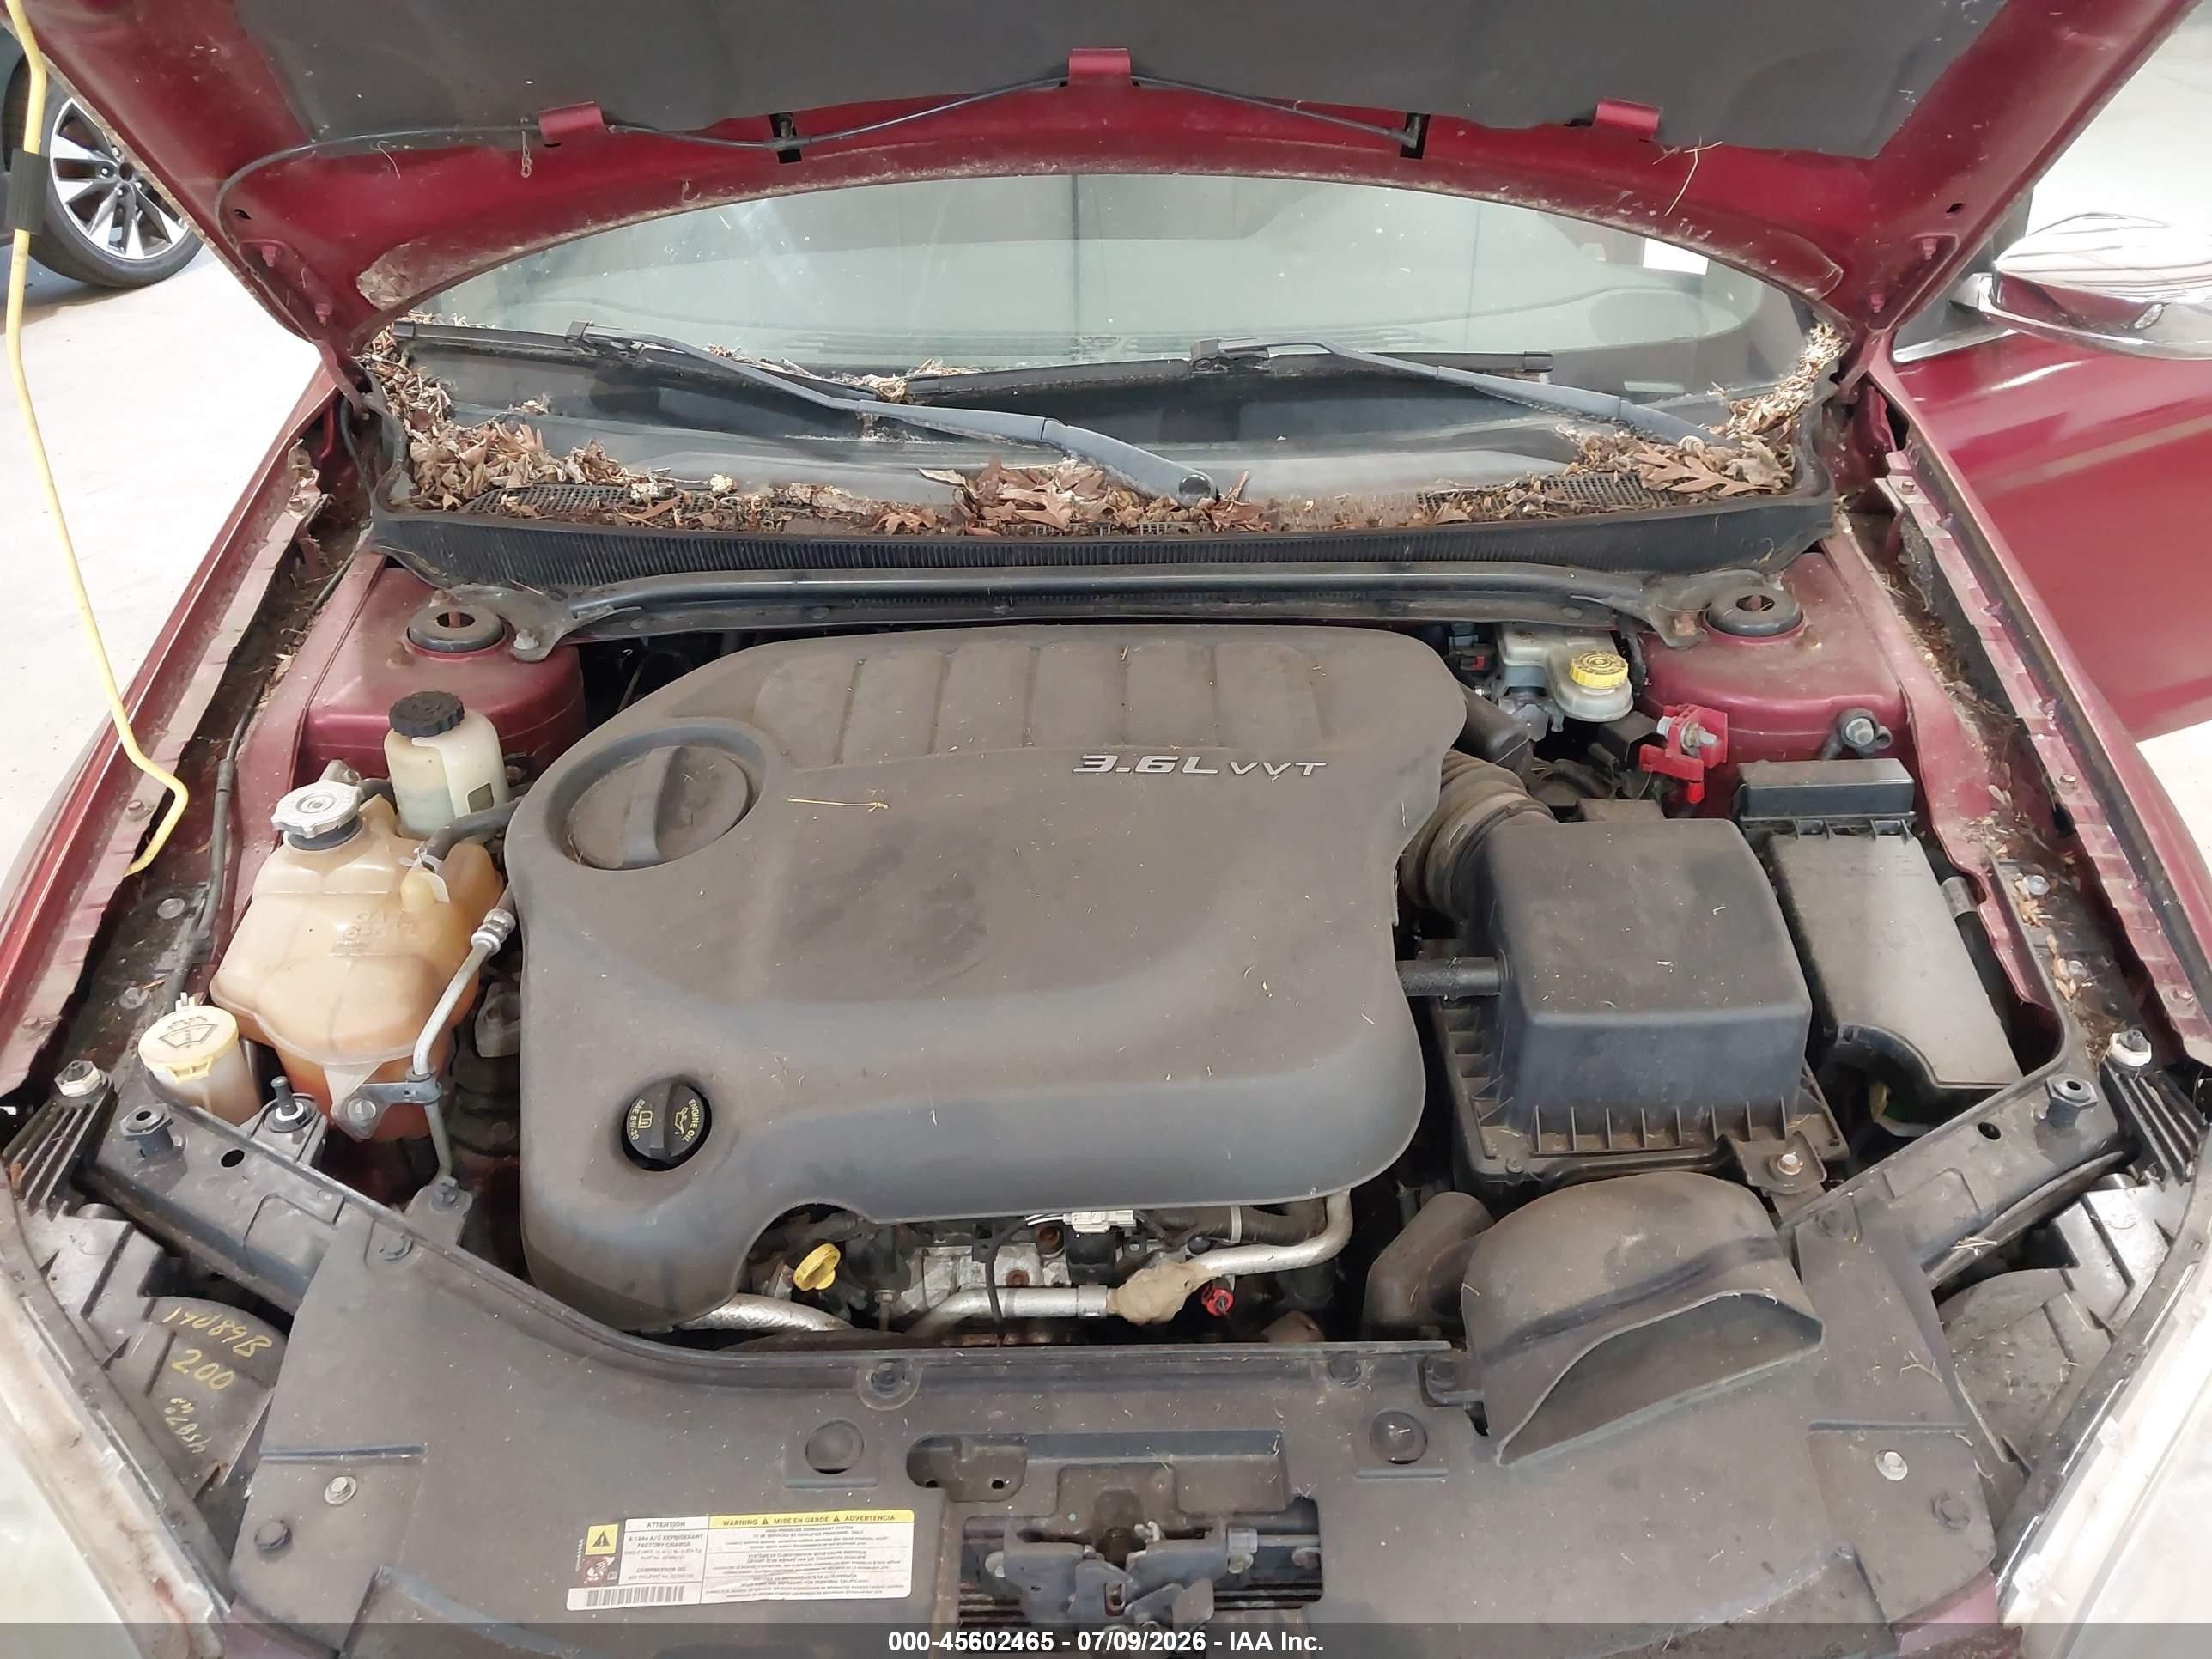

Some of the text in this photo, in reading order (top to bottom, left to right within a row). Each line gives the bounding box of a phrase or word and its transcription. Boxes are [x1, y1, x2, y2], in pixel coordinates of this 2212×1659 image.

[1072, 754, 1328, 776] 3.6L VVT
[632, 1098, 647, 1116] SAE
[680, 1098, 701, 1143] ENGINE OIL
[171, 1348, 235, 1390] 200
